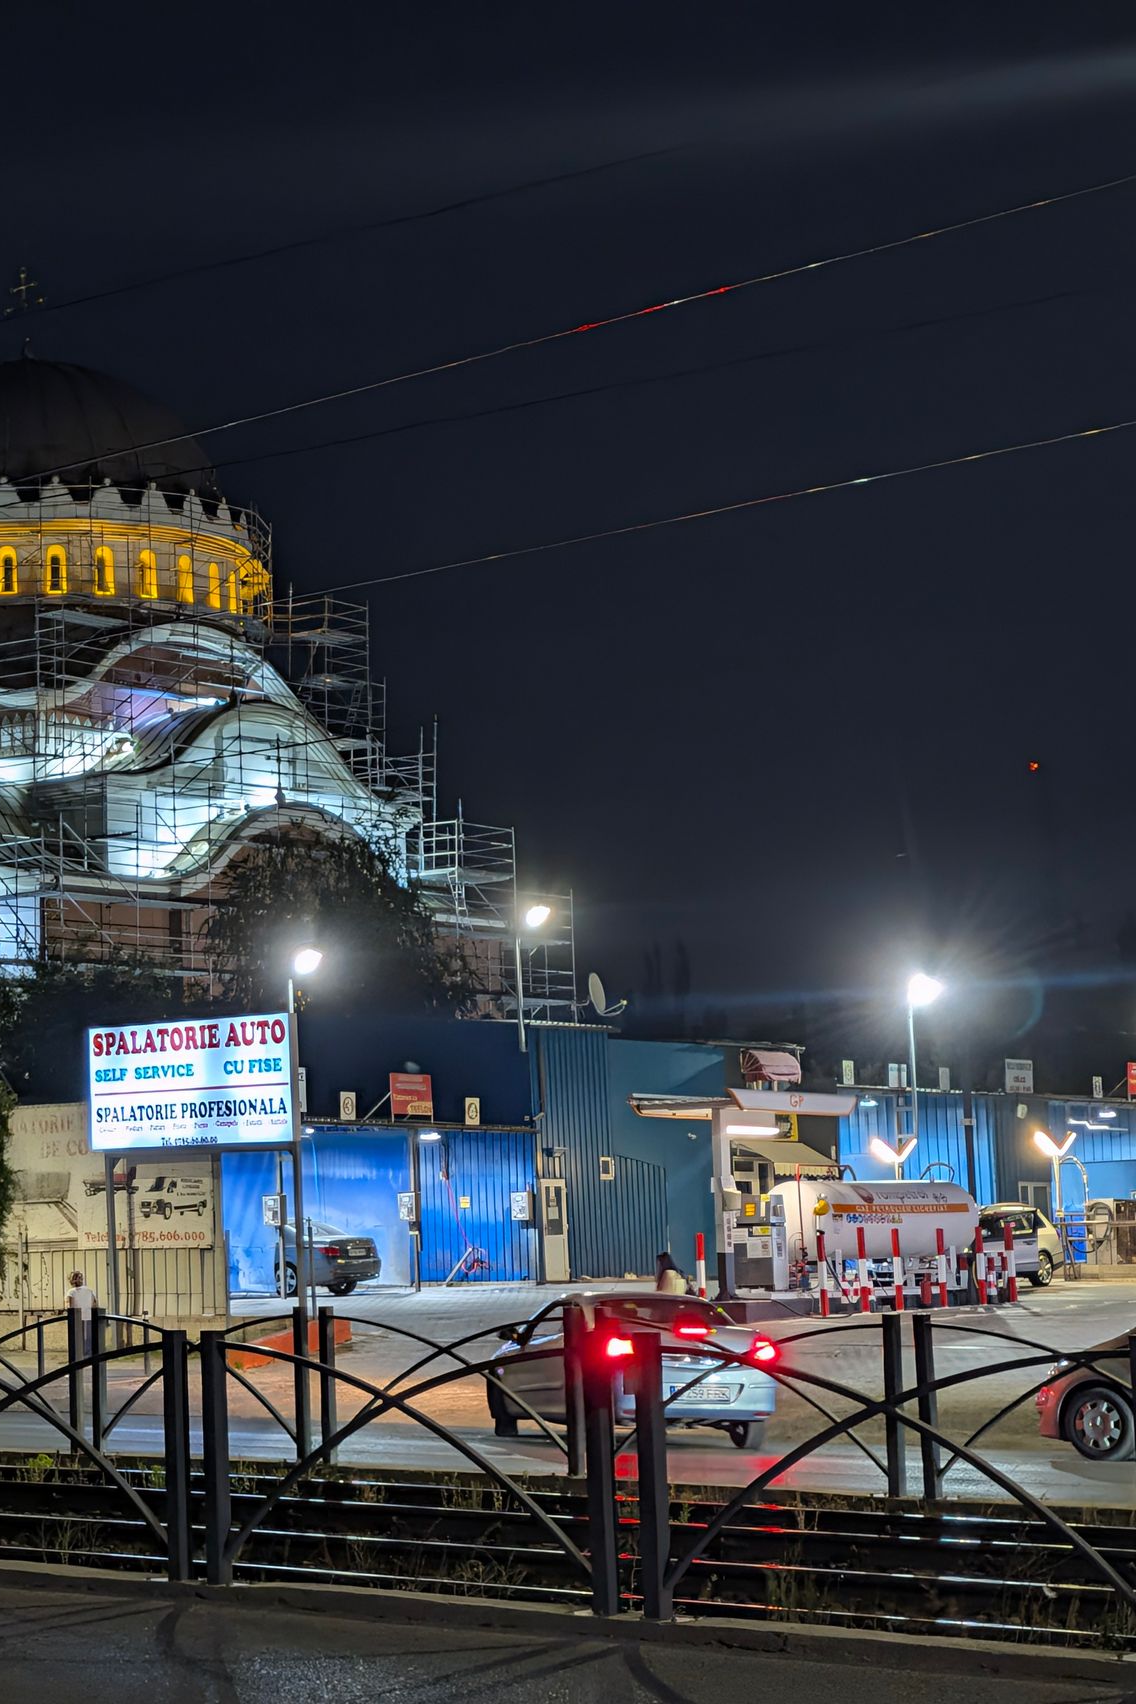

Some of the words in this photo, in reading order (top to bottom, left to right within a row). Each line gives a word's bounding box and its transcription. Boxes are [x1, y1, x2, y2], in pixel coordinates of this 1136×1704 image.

[93, 1024, 220, 1056] SPALATORIE
[225, 1019, 286, 1047] AUTO
[95, 1068, 128, 1082] SELF
[134, 1063, 194, 1079] SERVICE
[223, 1060, 244, 1075] CU
[249, 1058, 282, 1073] FISE
[96, 1103, 177, 1123] SPALATORIE
[181, 1097, 288, 1119] PROFESIONALA
[132, 1230, 205, 1243] 785.606.000
